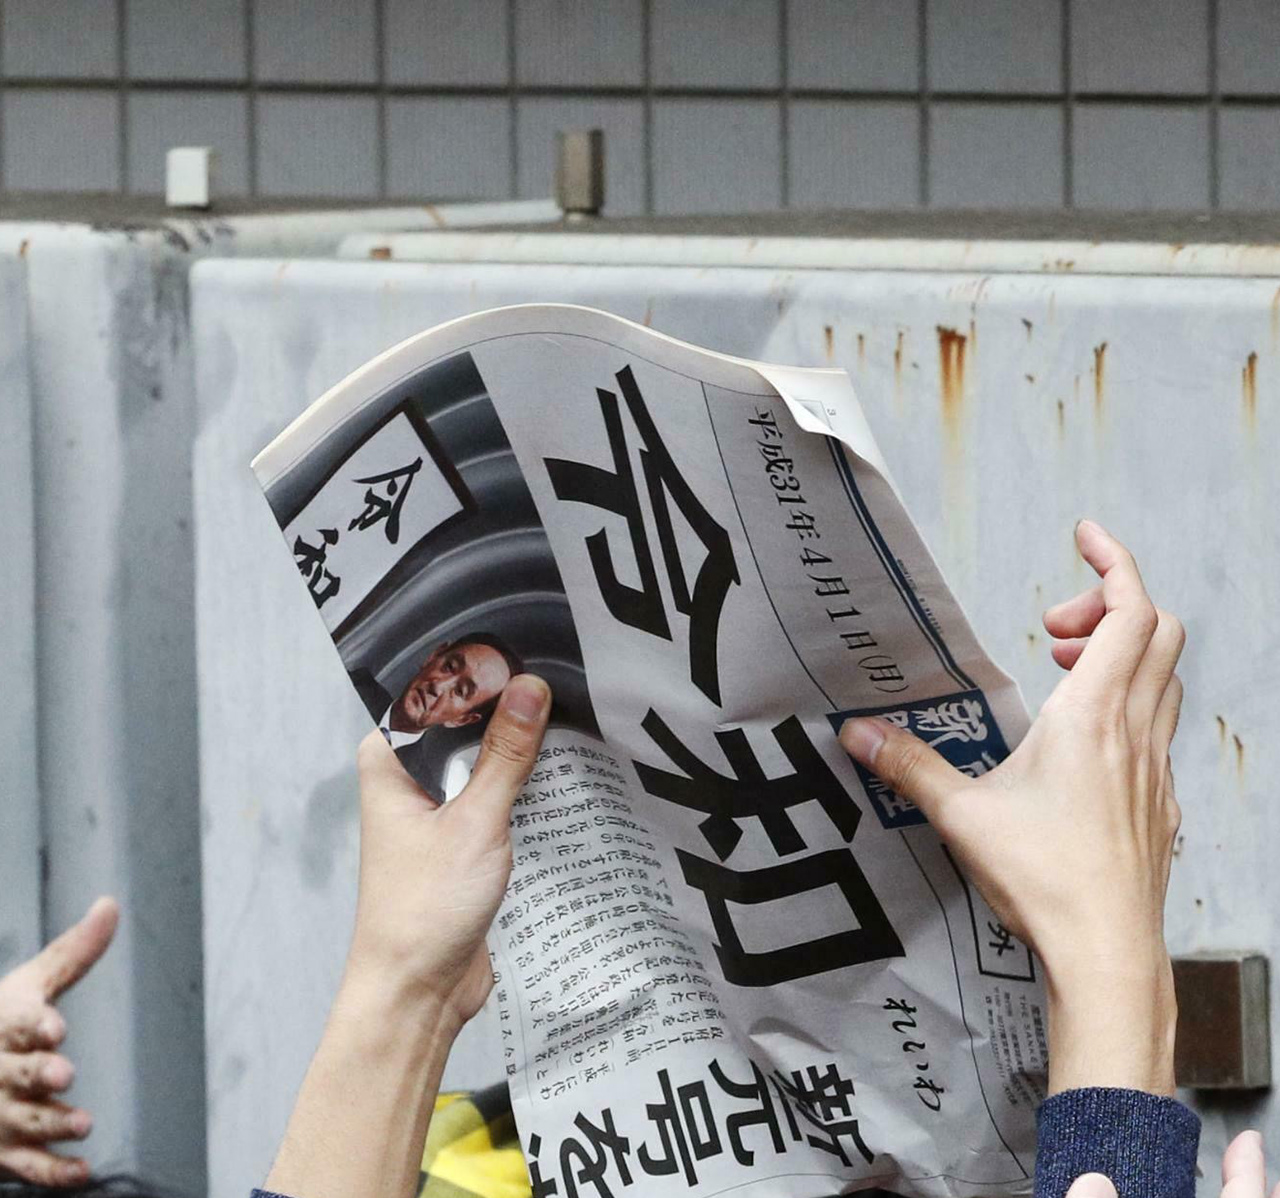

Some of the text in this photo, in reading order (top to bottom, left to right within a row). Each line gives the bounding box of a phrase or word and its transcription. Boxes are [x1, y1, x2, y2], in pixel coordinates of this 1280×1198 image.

[545, 365, 906, 988] 令和
[885, 994, 944, 1112] れいわ
